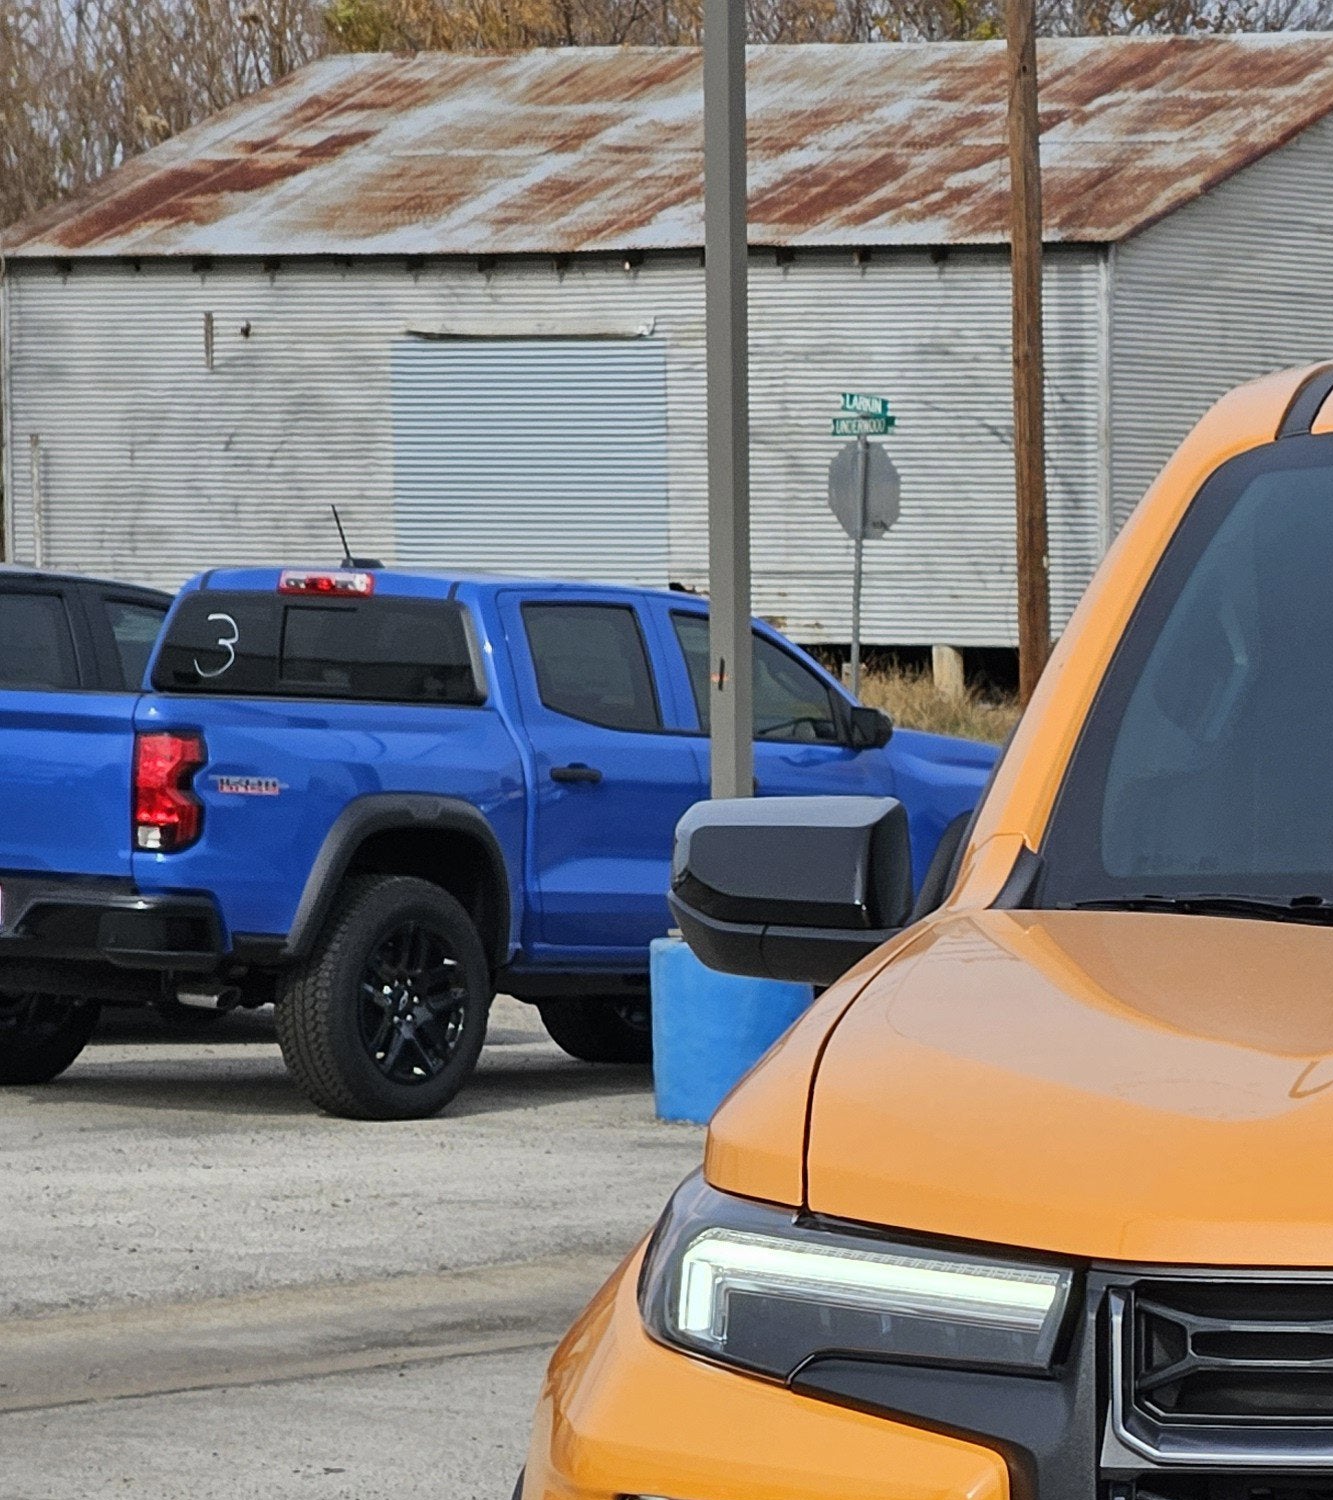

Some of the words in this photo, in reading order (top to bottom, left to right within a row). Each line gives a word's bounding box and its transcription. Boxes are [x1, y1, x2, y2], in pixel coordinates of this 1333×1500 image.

[846, 393, 882, 414] LARKIN
[836, 419, 886, 434] UNDERWOOD
[193, 612, 239, 678] 3
